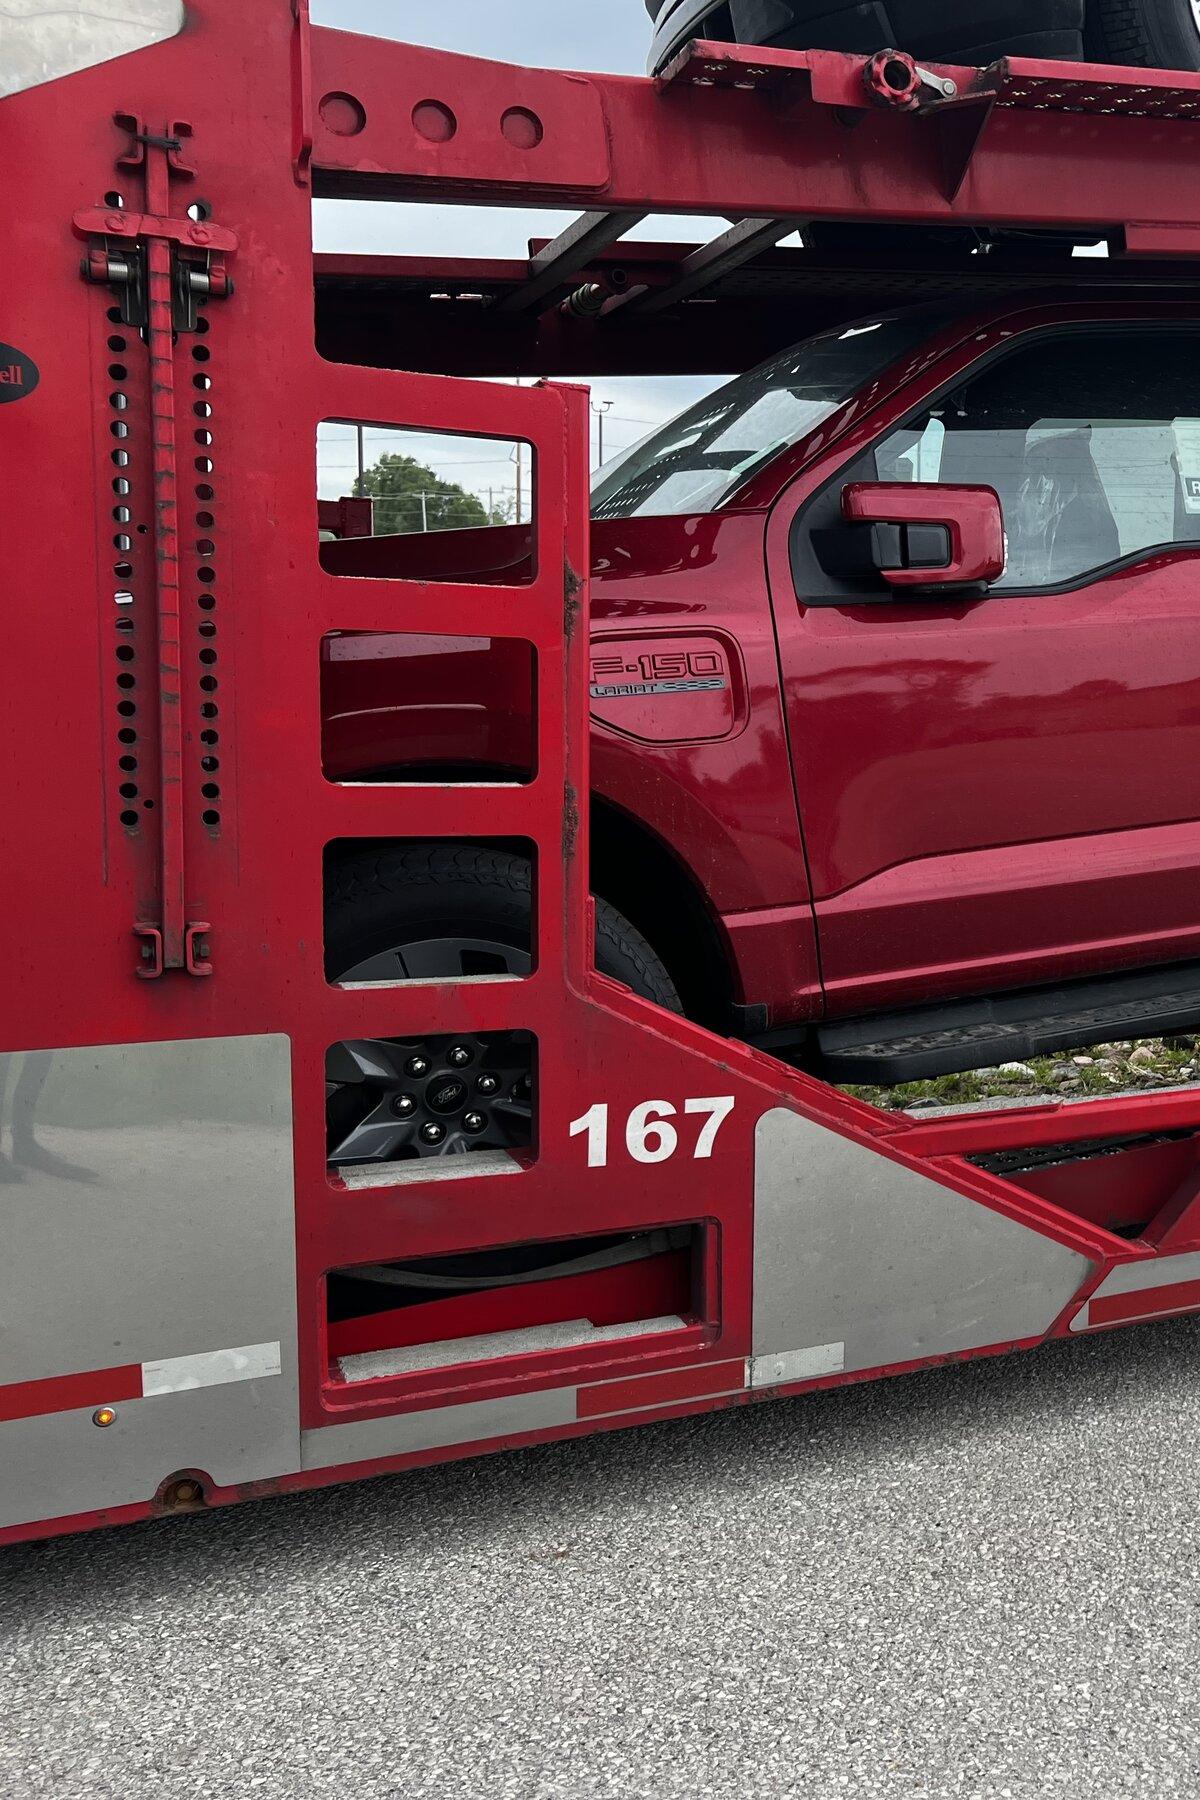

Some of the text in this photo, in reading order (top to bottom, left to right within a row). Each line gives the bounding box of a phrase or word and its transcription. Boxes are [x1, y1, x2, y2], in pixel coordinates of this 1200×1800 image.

[590, 651, 724, 683] F-150
[594, 683, 659, 695] LARIAT
[436, 1086, 458, 1104] Ford
[569, 1096, 735, 1168] 167
